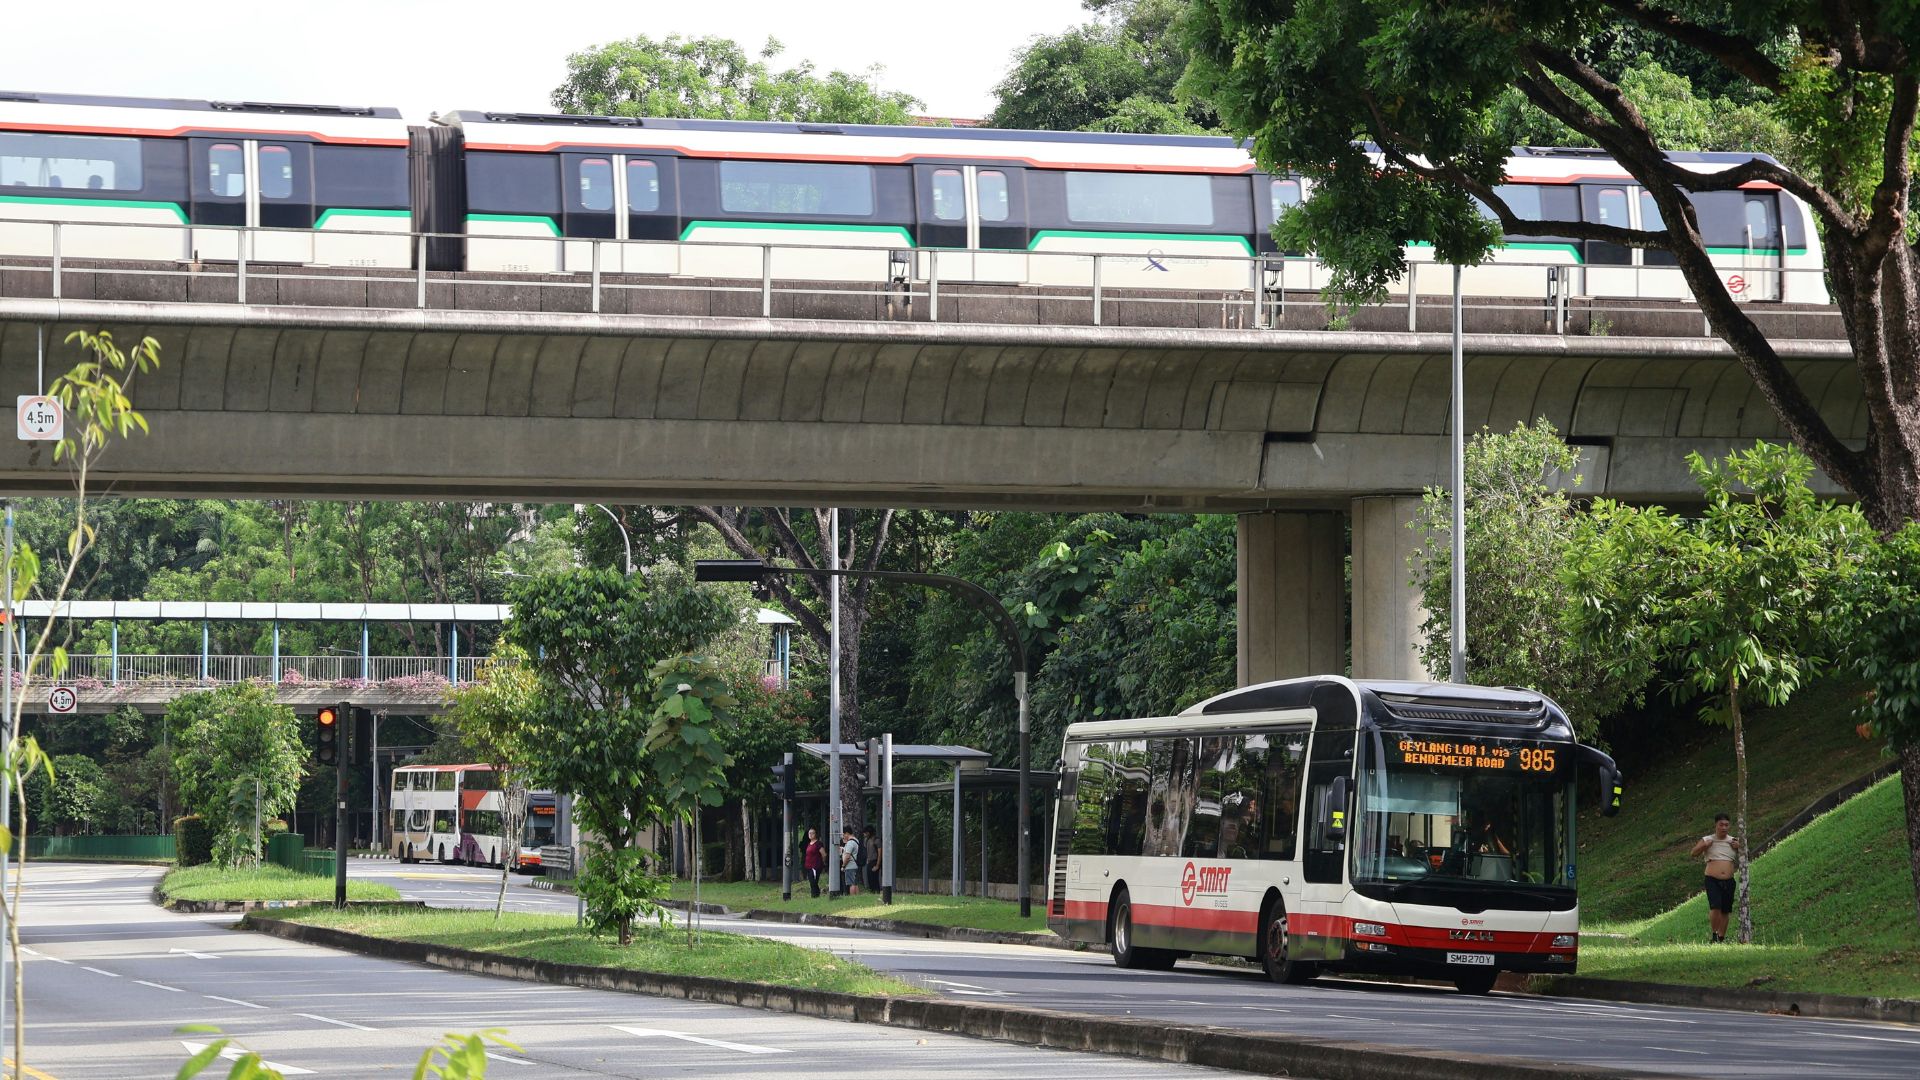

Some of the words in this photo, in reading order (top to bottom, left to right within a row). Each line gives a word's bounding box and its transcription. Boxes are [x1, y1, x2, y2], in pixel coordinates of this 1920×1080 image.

[27, 411, 55, 424] 4.5m
[53, 696, 72, 705] 4.5m
[1399, 740, 1451, 754] GEYLANG
[1455, 743, 1477, 756] LOR
[1480, 744, 1485, 756] 1
[1492, 747, 1510, 758] via
[1404, 753, 1473, 767] BENDEMEER
[1476, 757, 1505, 769] ROAD
[1519, 748, 1556, 772] 985
[1196, 866, 1232, 893] SMRT
[1450, 954, 1491, 964] SMB270Y
